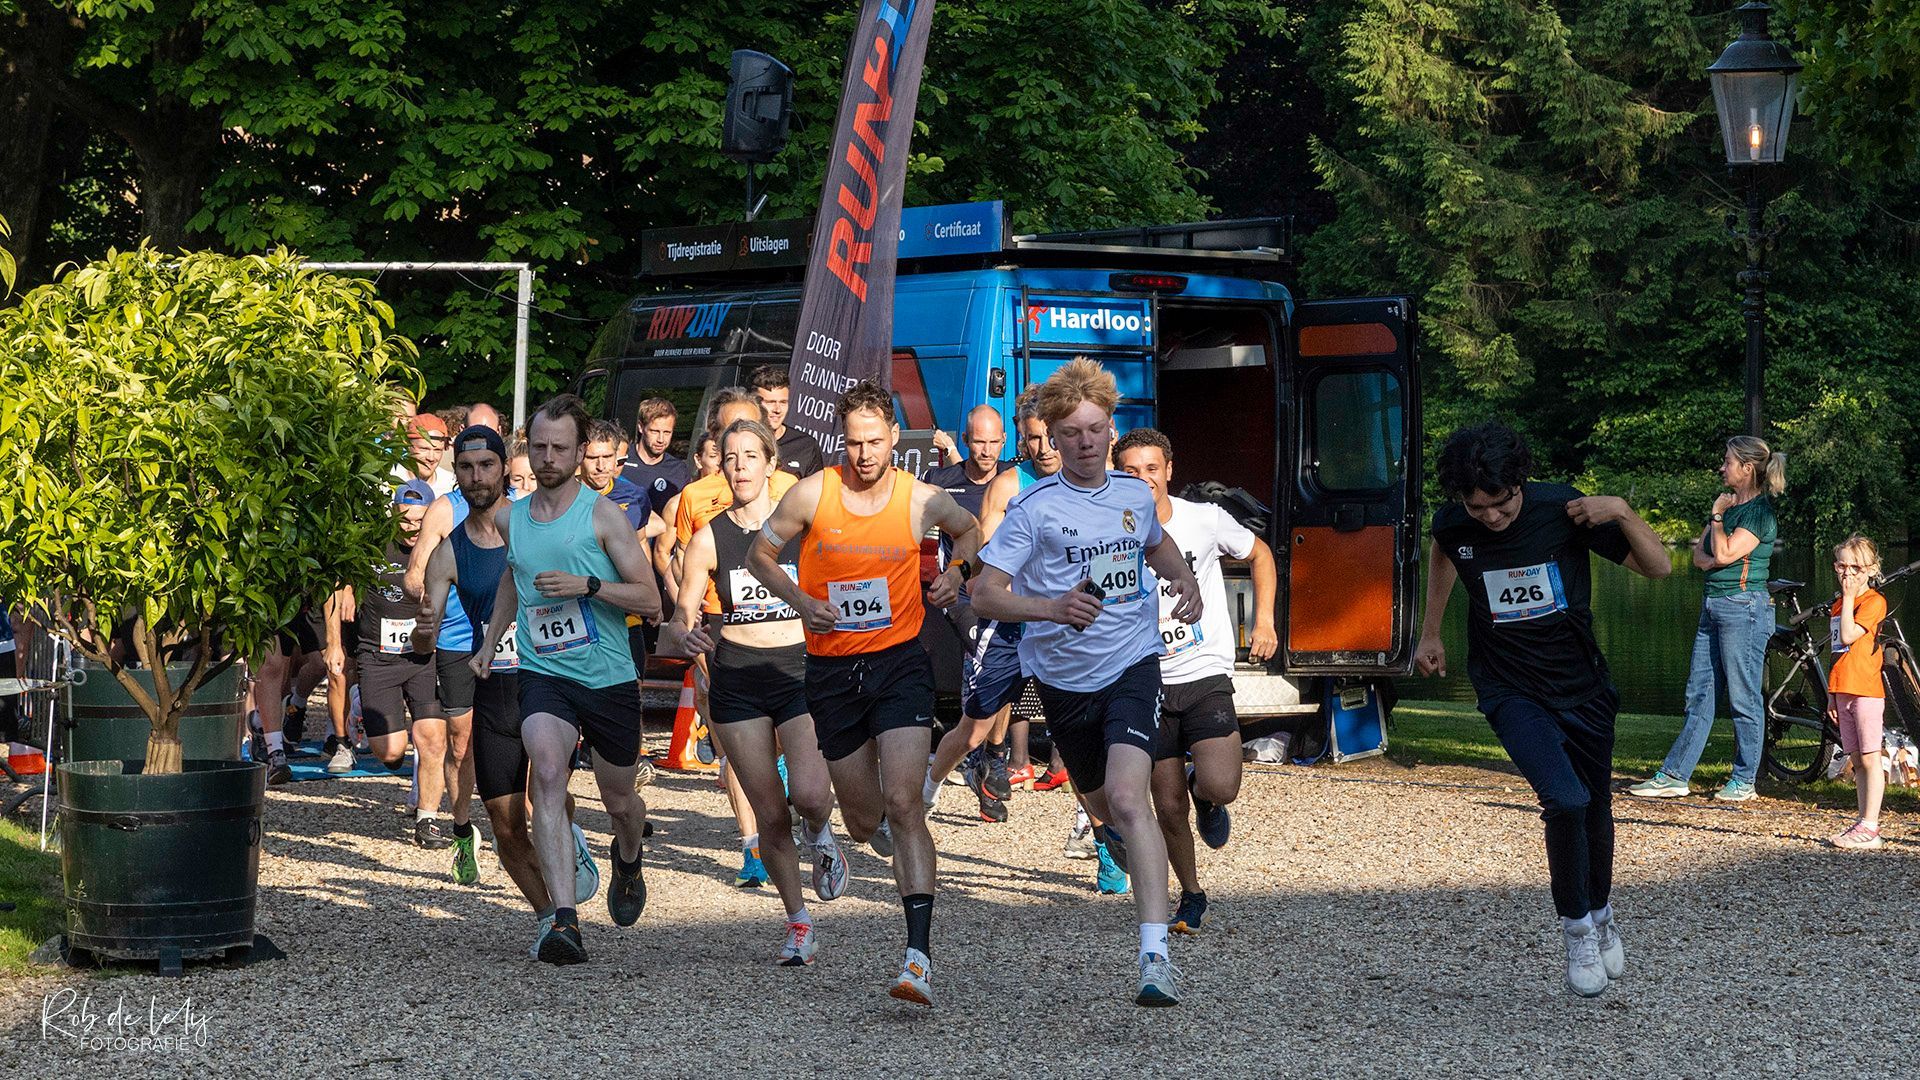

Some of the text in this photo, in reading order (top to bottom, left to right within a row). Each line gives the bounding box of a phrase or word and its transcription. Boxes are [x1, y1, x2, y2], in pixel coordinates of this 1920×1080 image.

[934, 220, 981, 239] Certificaat
[667, 240, 722, 261] Tijdregistratie
[750, 236, 789, 254] Uitslagen
[806, 330, 842, 361] DOOR
[800, 362, 868, 395] RUNNER
[797, 393, 835, 423] VOOR
[1101, 569, 1137, 590] 409
[741, 585, 777, 601] 26
[1499, 584, 1545, 605] 426
[731, 610, 768, 623] PRO
[840, 596, 883, 617] 194
[389, 632, 409, 644] 16
[539, 618, 576, 640] 161
[1161, 626, 1186, 645] 06
[495, 637, 515, 653] 61
